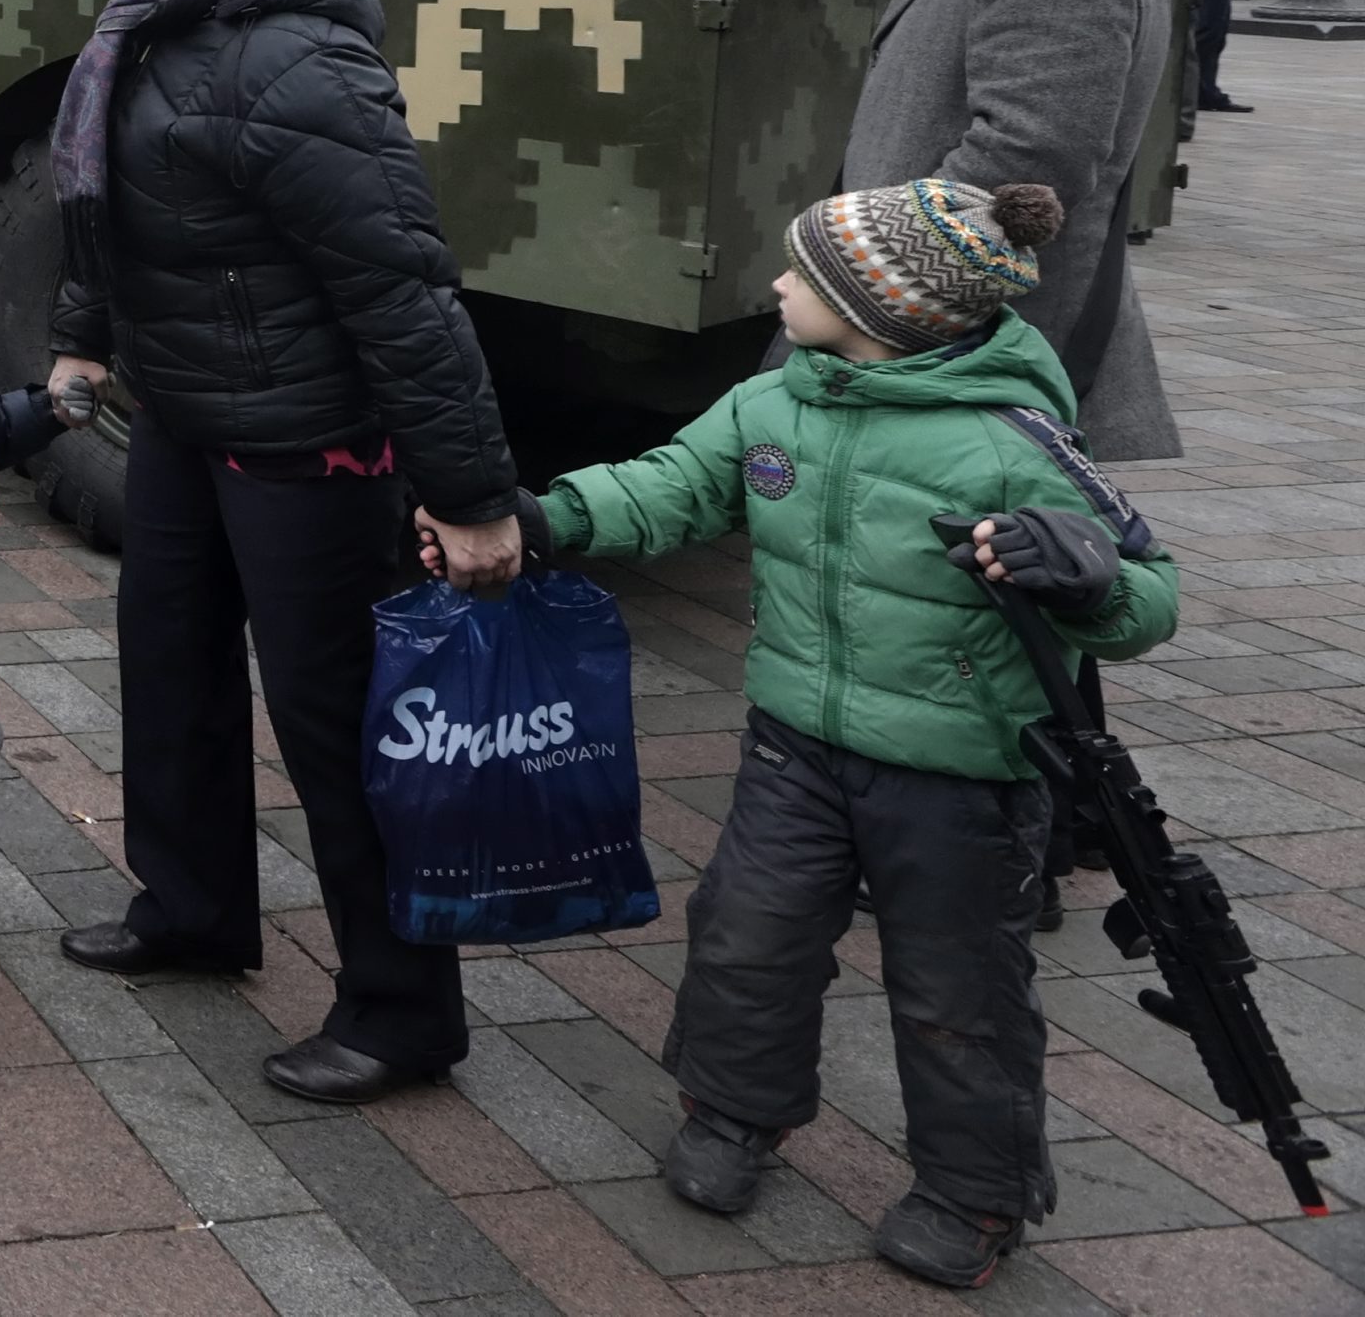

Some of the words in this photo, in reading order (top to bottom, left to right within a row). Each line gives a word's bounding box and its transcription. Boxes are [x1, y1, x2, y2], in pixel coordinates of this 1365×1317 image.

[377, 686, 575, 768] Strauss
[496, 859, 546, 874] MODE
[571, 840, 633, 862] GENUSS
